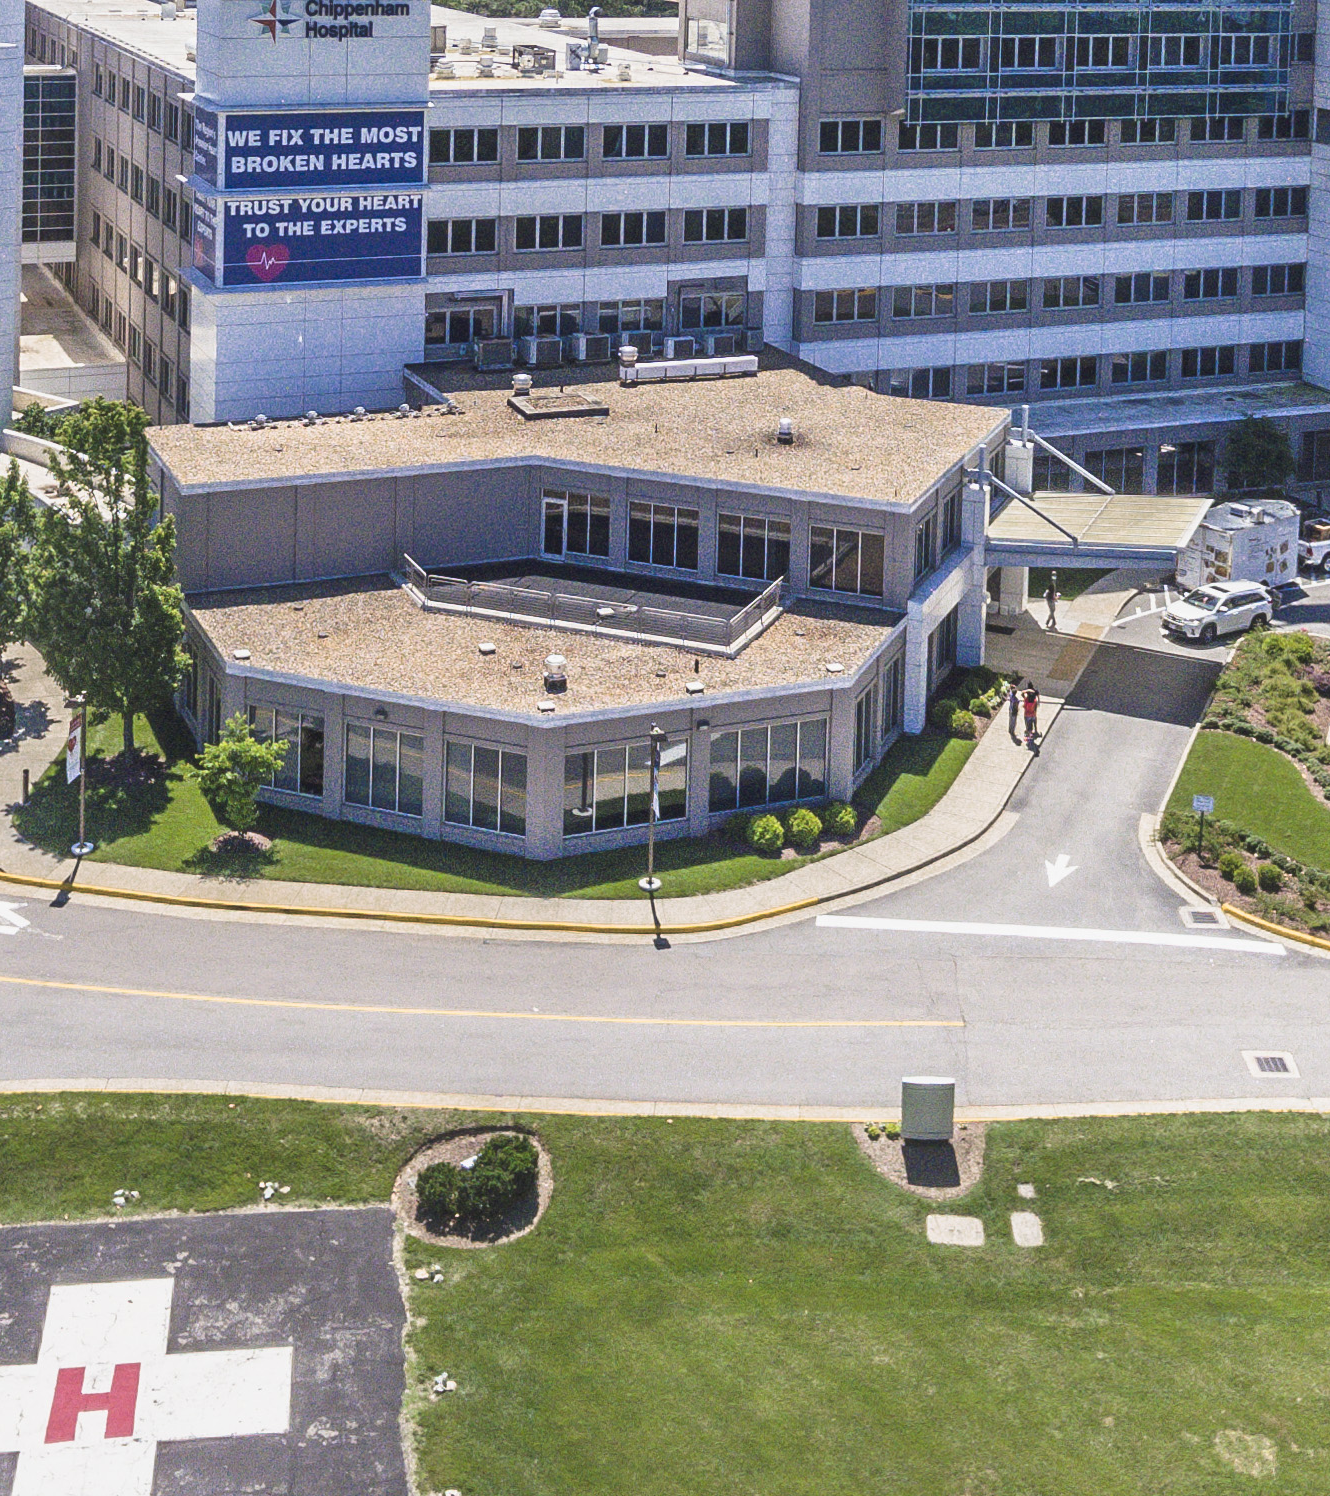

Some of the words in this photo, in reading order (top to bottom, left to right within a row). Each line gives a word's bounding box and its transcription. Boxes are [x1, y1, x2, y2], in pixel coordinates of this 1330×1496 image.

[305, 21, 373, 42] Hospital
[227, 129, 261, 147] WE
[269, 128, 303, 146] FIX
[310, 127, 354, 145] THE
[361, 126, 422, 145] MOST
[231, 154, 324, 173] BROKEN
[332, 151, 417, 171] HEARTS
[227, 199, 293, 216] TRUST
[298, 197, 353, 214] YOUR
[359, 194, 422, 212] HEART
[243, 222, 270, 238] TO
[276, 220, 314, 237] THE
[321, 217, 406, 235] EXPERTS
[44, 1361, 140, 1444] H
